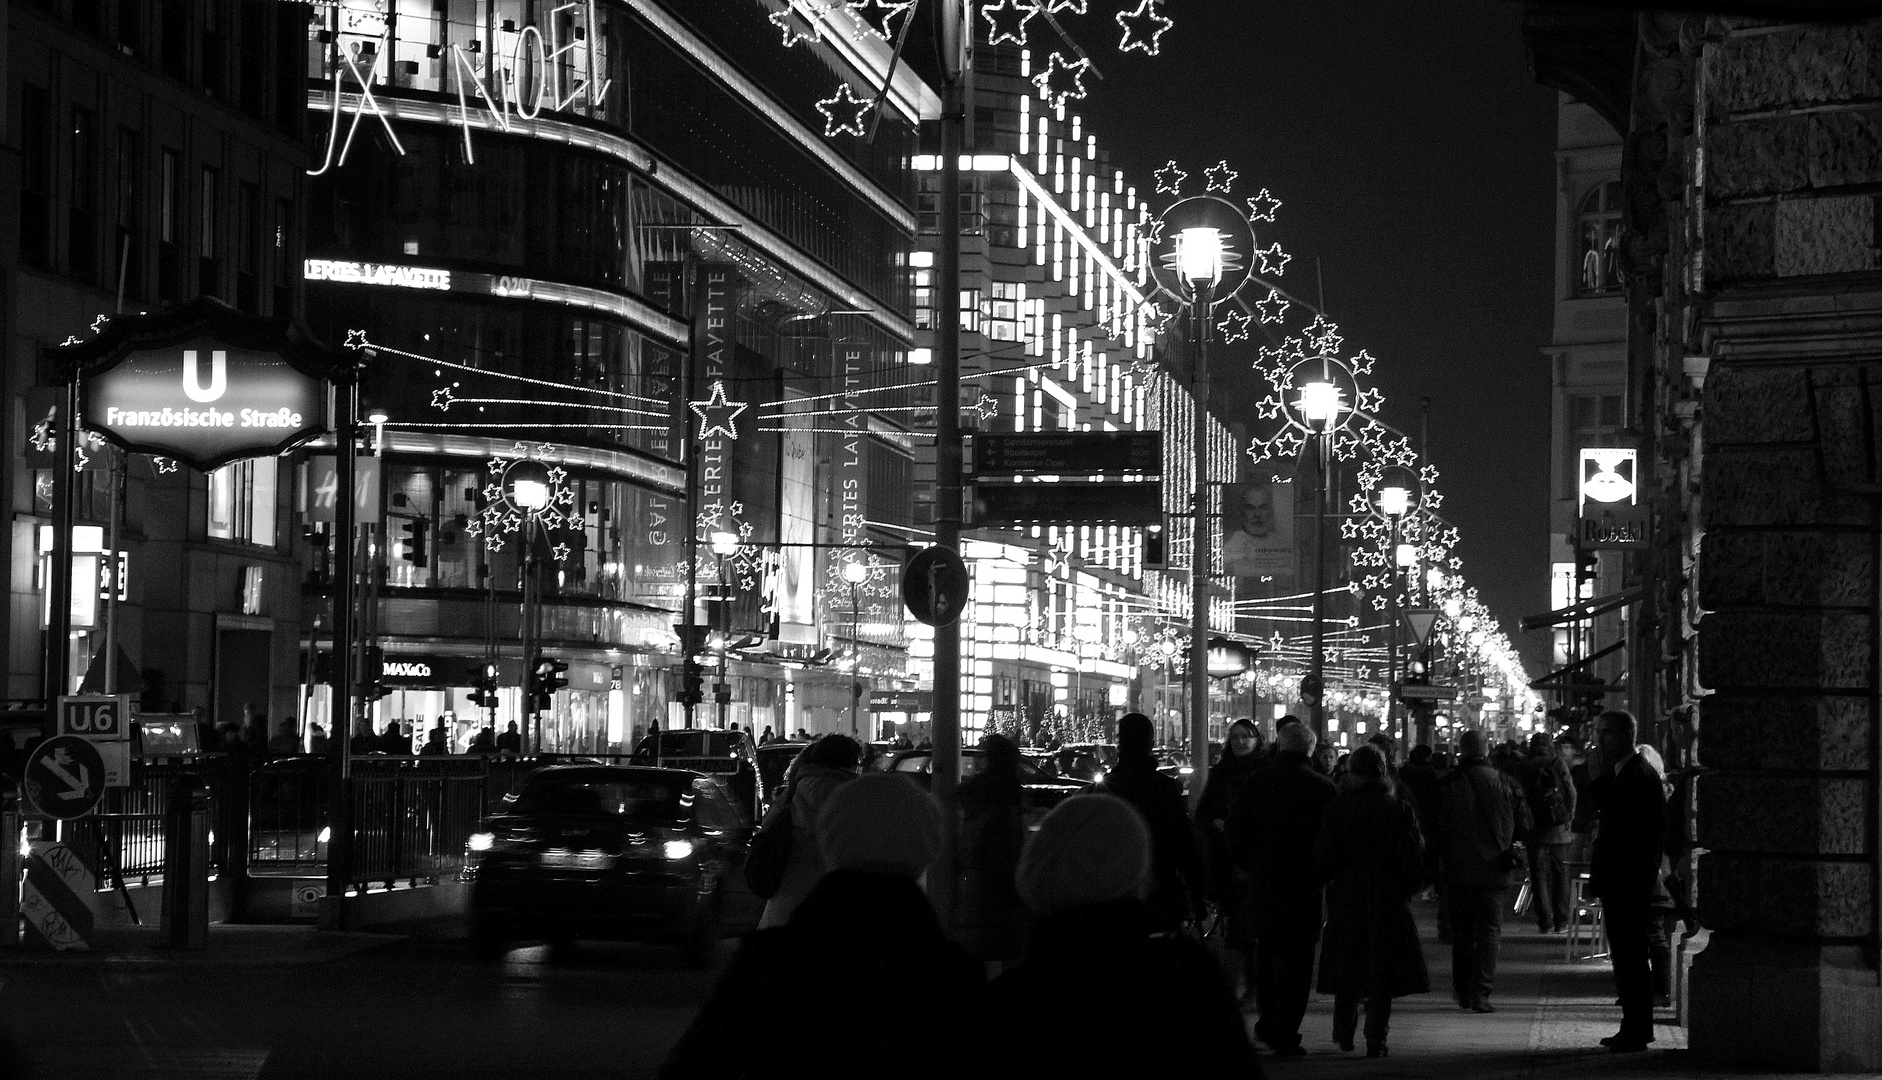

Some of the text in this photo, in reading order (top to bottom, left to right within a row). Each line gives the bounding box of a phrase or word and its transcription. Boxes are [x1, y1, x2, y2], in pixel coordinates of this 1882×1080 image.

[361, 263, 451, 291] LAFAYETTE
[182, 349, 227, 403] U
[105, 406, 303, 428] Französische Straße
[610, 680, 622, 690] 78
[70, 704, 112, 731] U6
[414, 714, 424, 752] SALE
